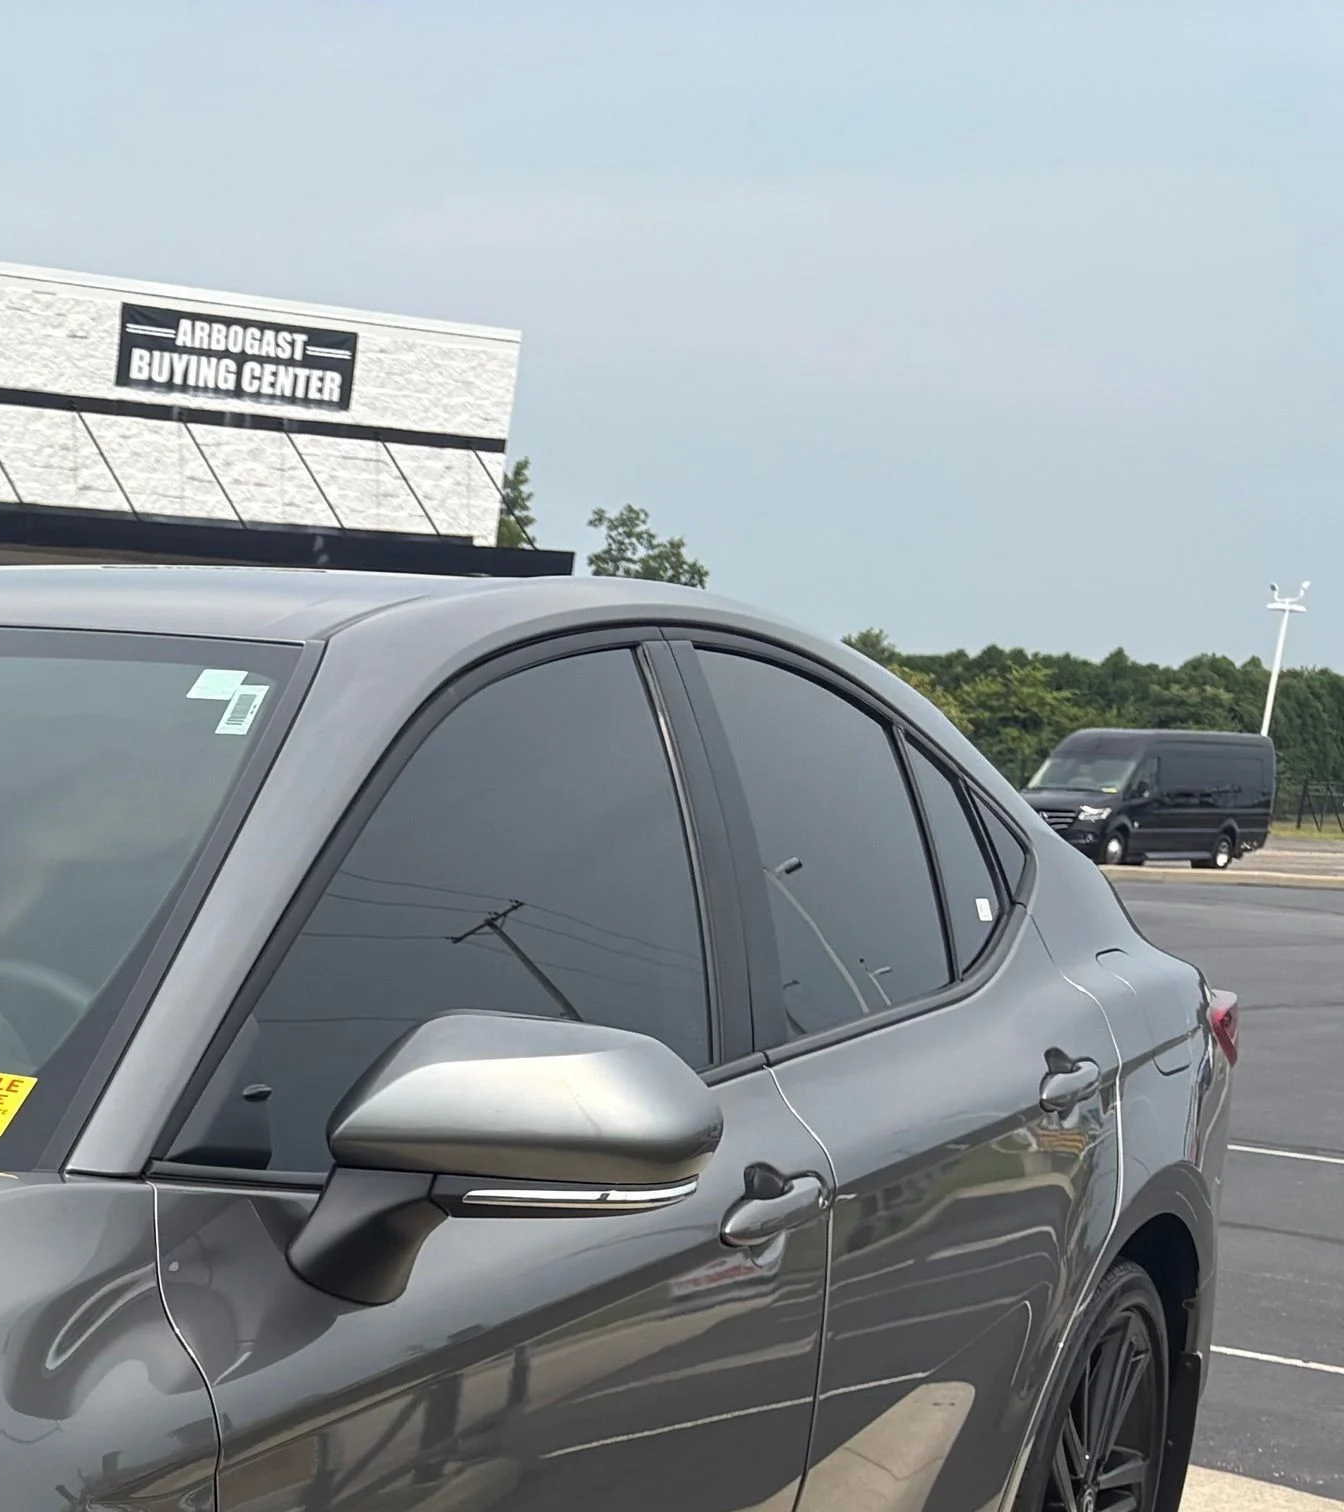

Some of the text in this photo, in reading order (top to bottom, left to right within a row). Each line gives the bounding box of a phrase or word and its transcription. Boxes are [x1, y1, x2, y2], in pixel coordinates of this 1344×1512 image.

[175, 318, 309, 361] ARBOGAST
[129, 347, 343, 403] BUYING CENTER
